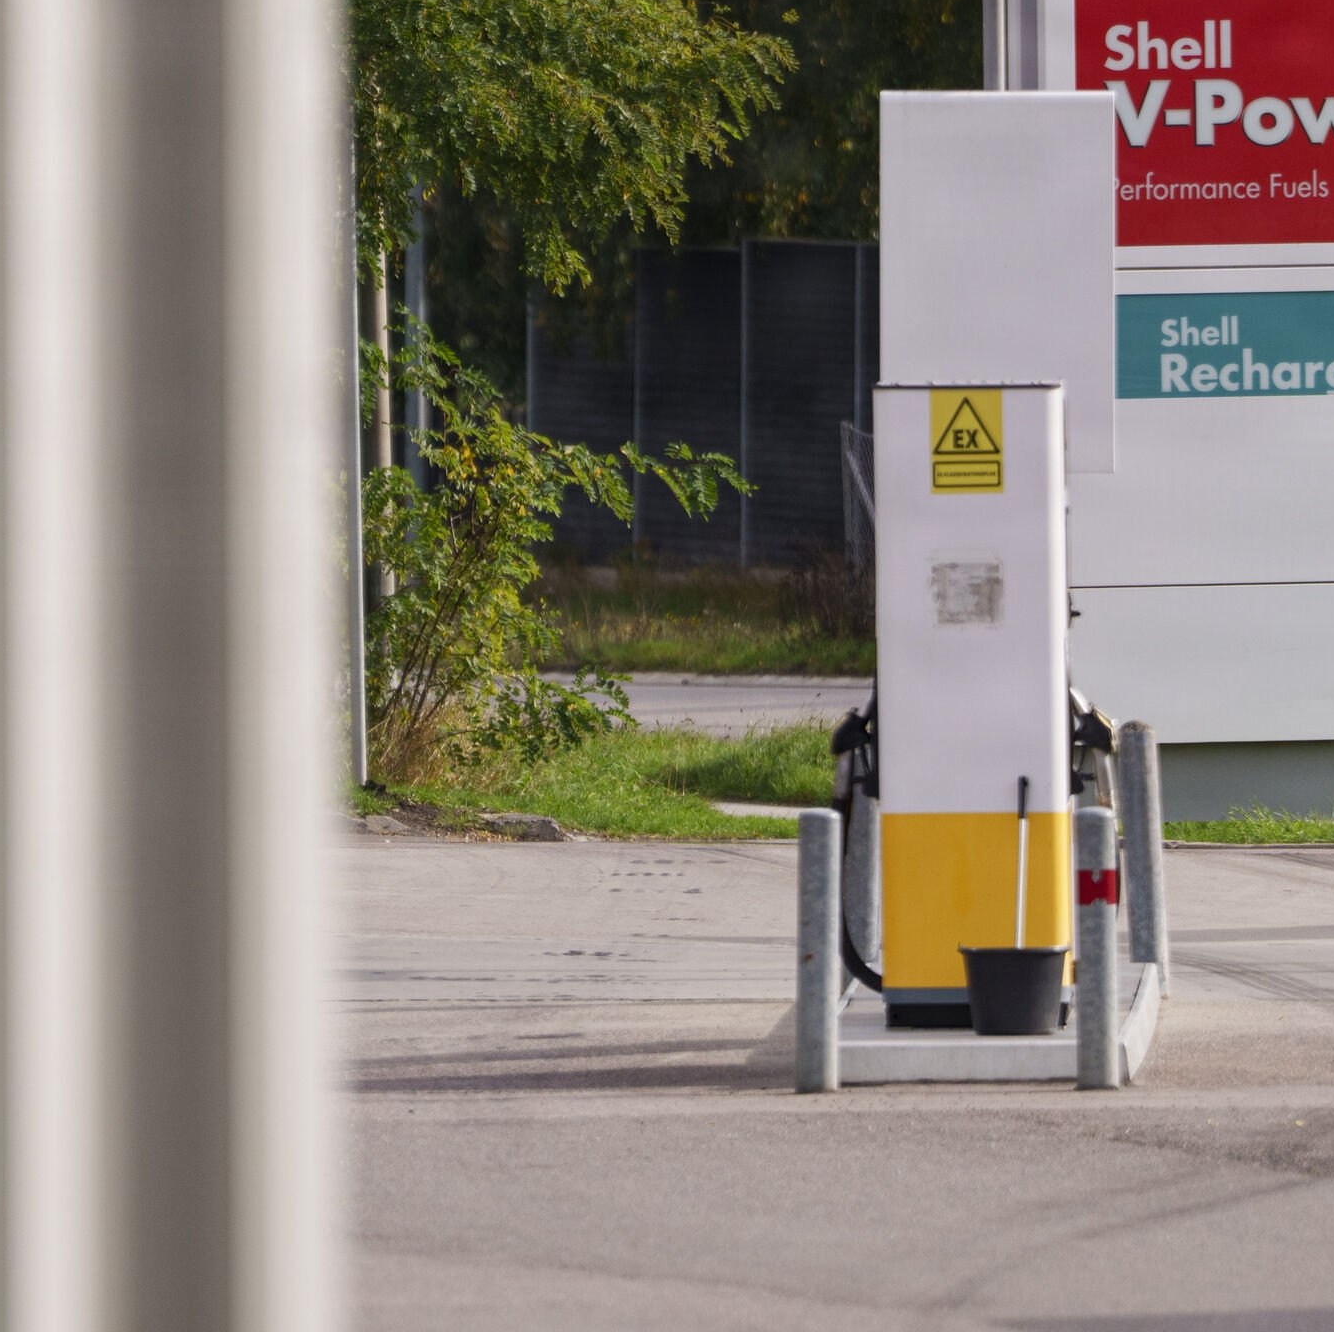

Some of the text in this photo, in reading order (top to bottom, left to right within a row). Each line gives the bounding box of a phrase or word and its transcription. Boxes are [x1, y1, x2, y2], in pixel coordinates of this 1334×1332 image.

[1103, 19, 1233, 72] Shell
[1269, 169, 1330, 199] Fuels
[1160, 315, 1240, 347] Shell
[952, 428, 979, 449] EX
